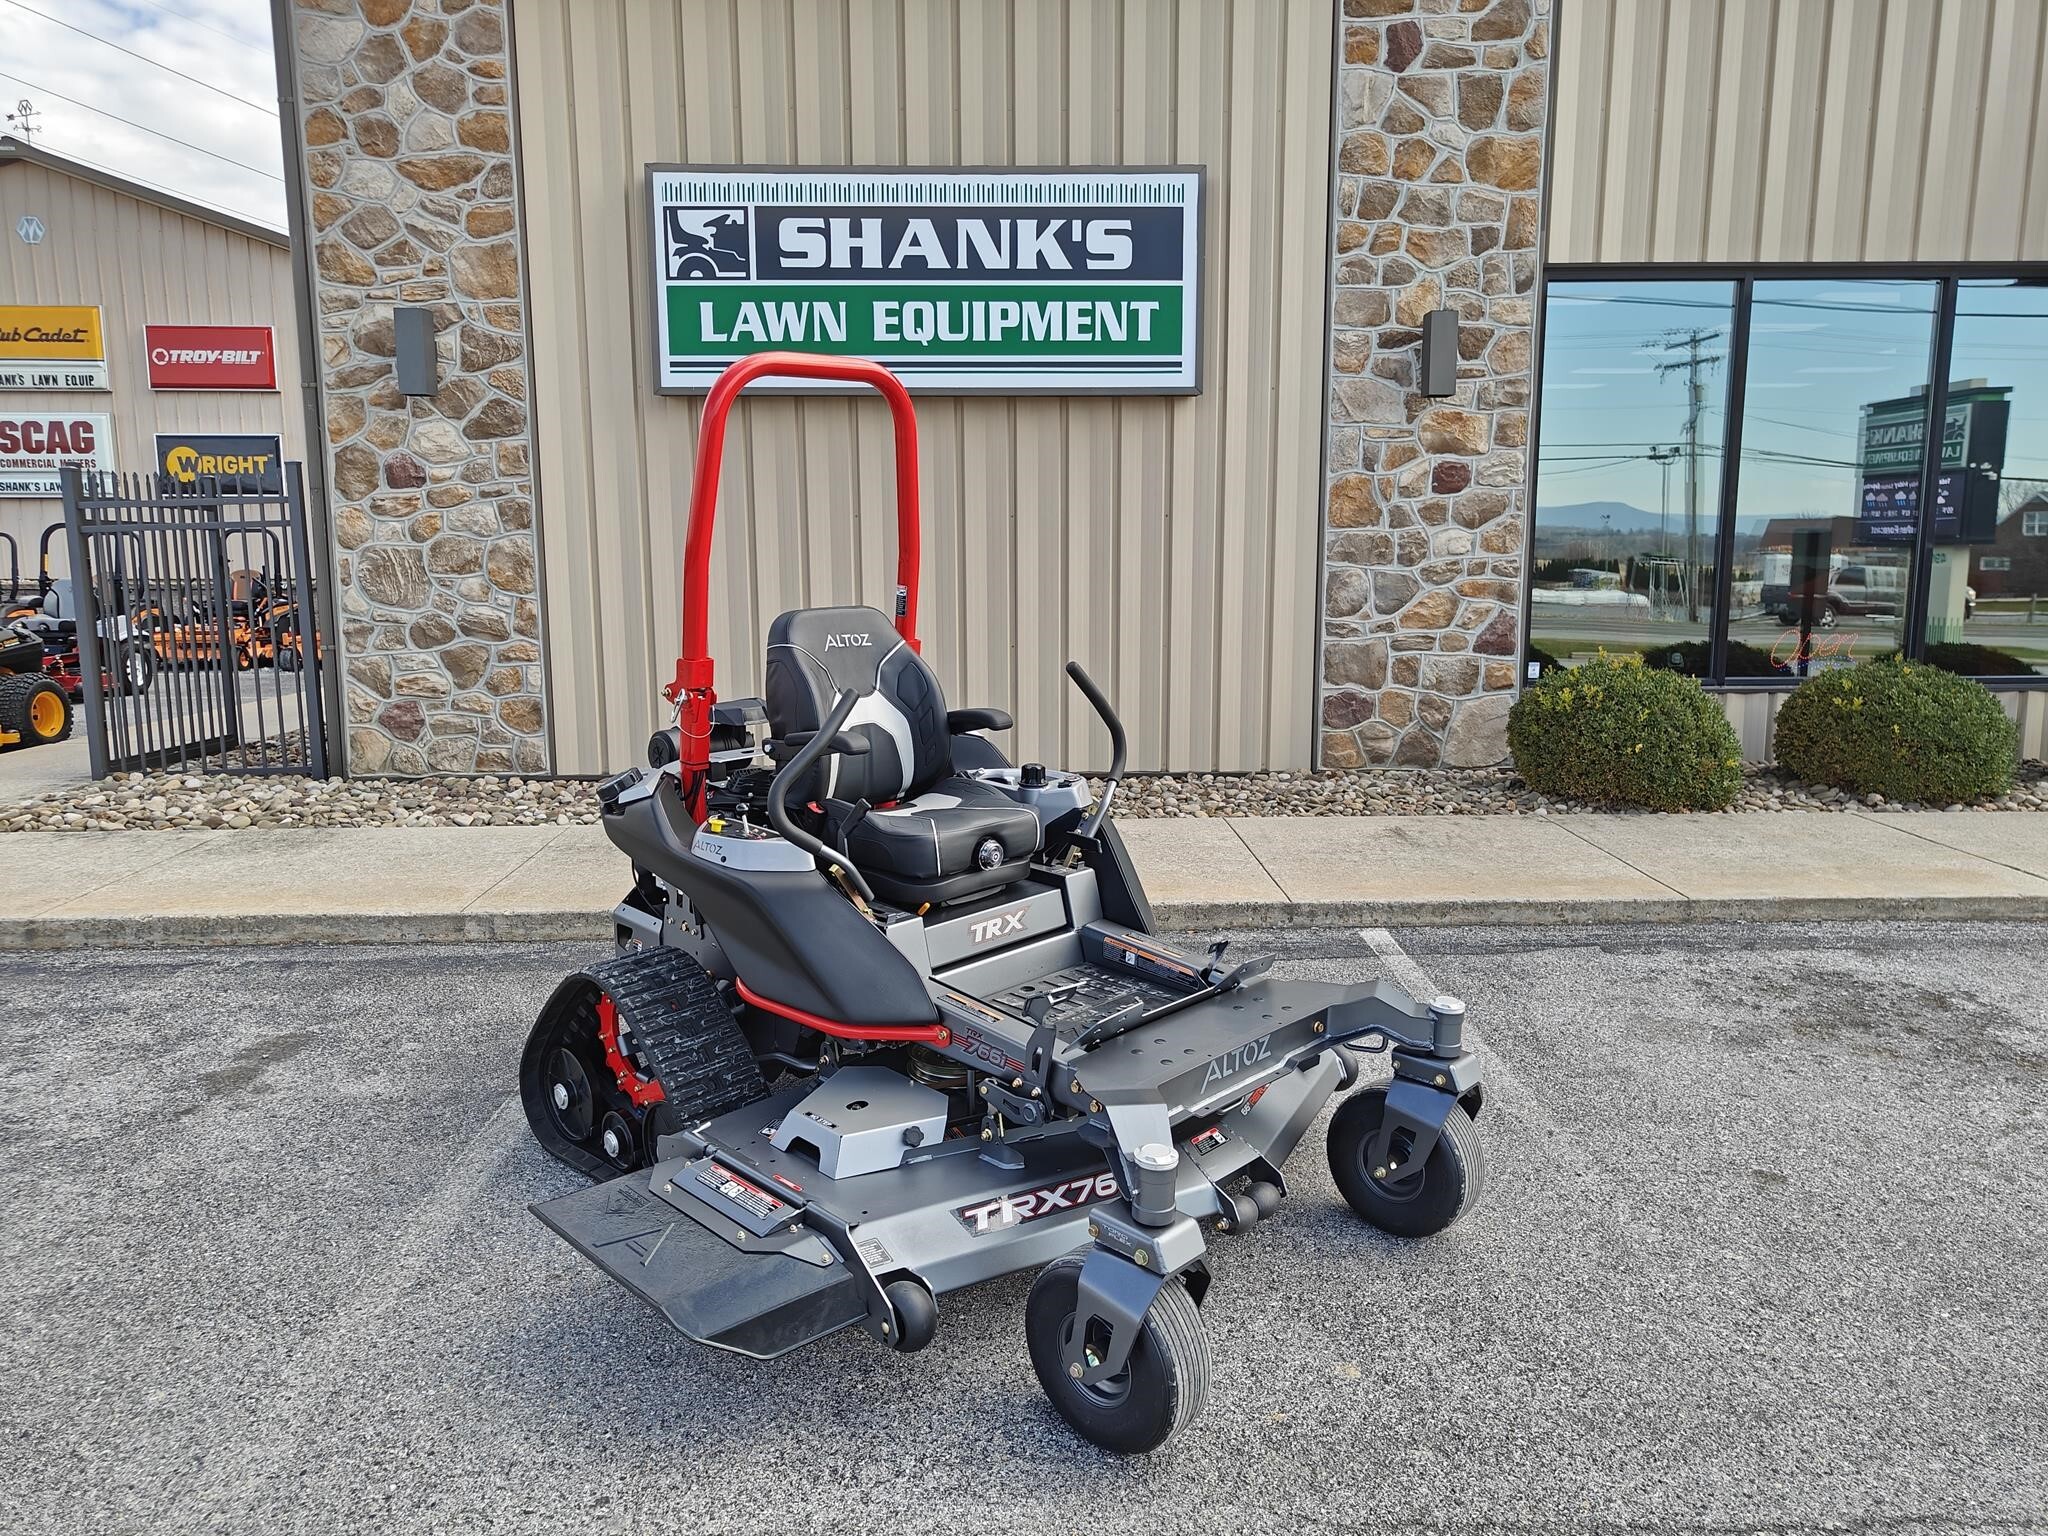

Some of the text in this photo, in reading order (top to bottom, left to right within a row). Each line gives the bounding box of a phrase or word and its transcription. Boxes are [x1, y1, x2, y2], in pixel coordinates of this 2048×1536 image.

[778, 217, 1133, 270] SHANK'S
[700, 301, 1160, 346] LAWN EQUIPMENT
[0, 327, 88, 343] ub Cadet
[169, 350, 261, 364] TROY-BILT
[32, 375, 58, 386] LAWN
[0, 421, 95, 454] SCAG
[0, 459, 96, 468] COMMERCIAL MERS
[177, 456, 268, 475] WRIGHT
[0, 482, 61, 491] SHANK'S LAW
[825, 634, 872, 652] ALTOZ
[694, 840, 723, 855] ALTOZ
[971, 910, 1025, 943] TRX
[1200, 1034, 1271, 1094] ALTOZ
[964, 1173, 1118, 1231] TRX76
